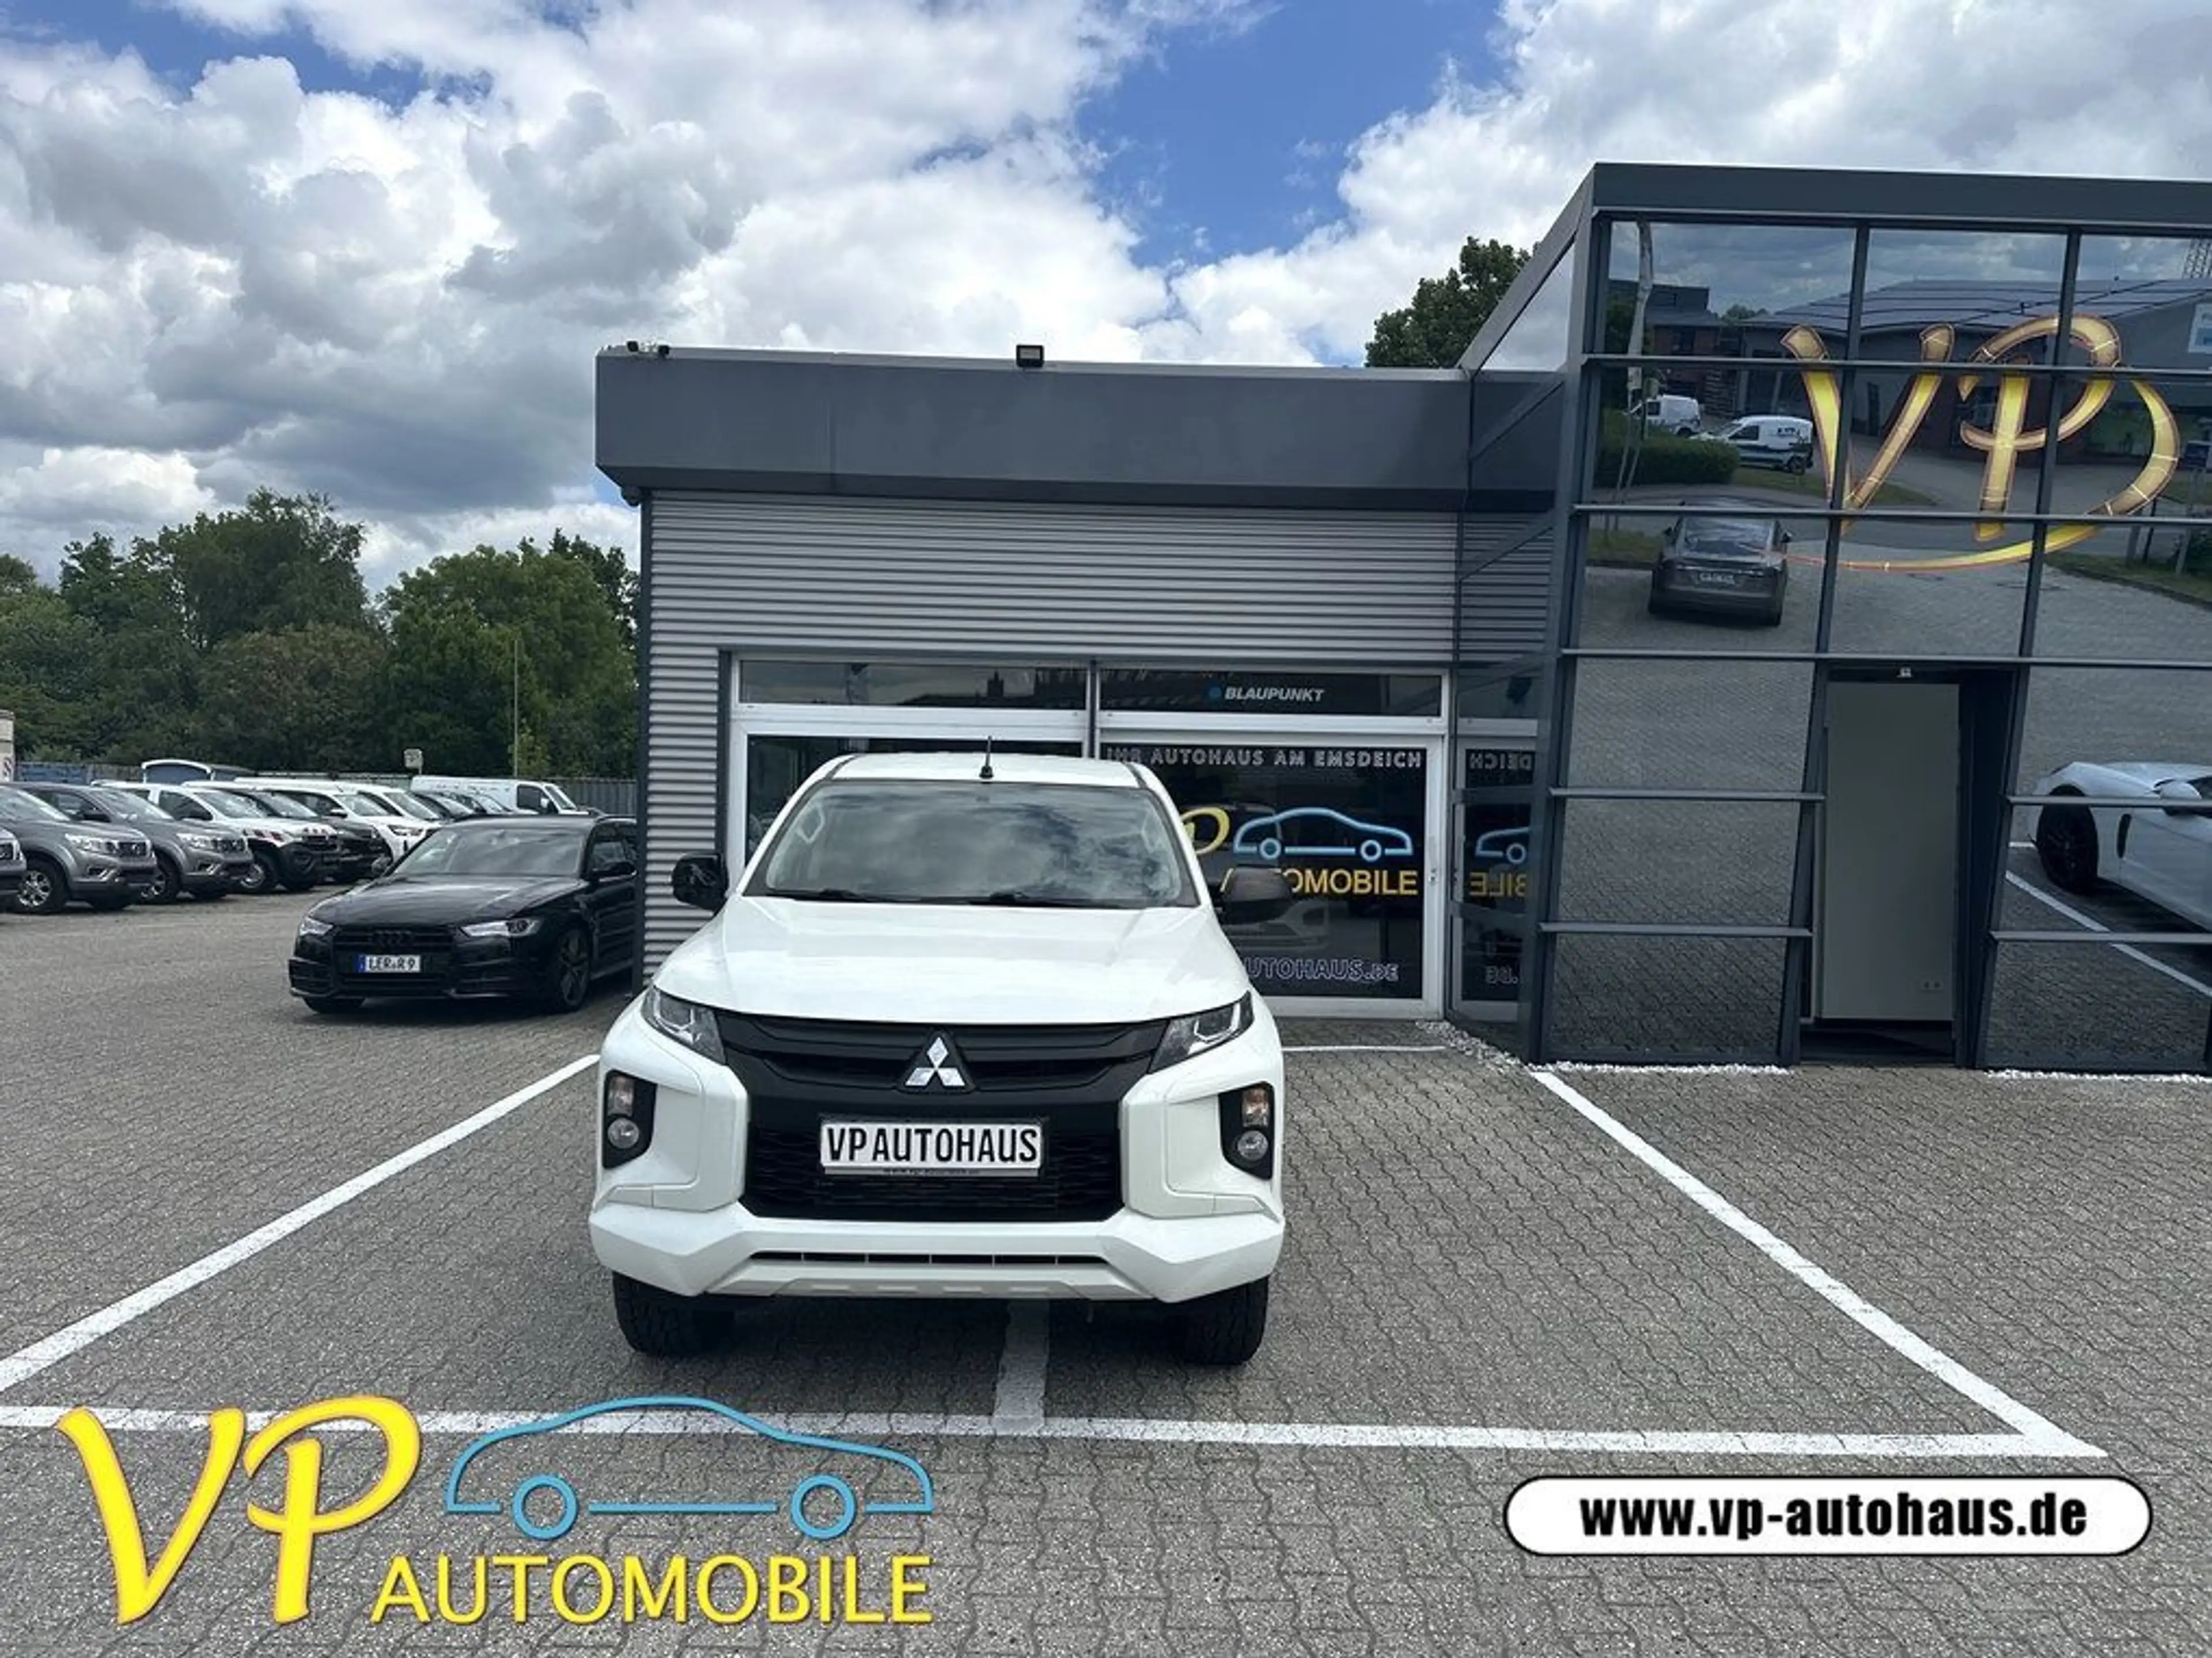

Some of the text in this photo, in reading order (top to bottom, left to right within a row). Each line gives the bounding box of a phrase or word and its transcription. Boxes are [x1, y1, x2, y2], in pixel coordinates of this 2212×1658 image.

[1224, 686, 1325, 702] BLAUPUNKT
[1106, 747, 1422, 768] IHR AUTOHAUS AM EMSDEICH
[1220, 868, 1419, 896] OMOBILE
[1243, 957, 1400, 982] UTOHAUS.DE
[827, 1127, 1037, 1162] VP AUTOHAUS
